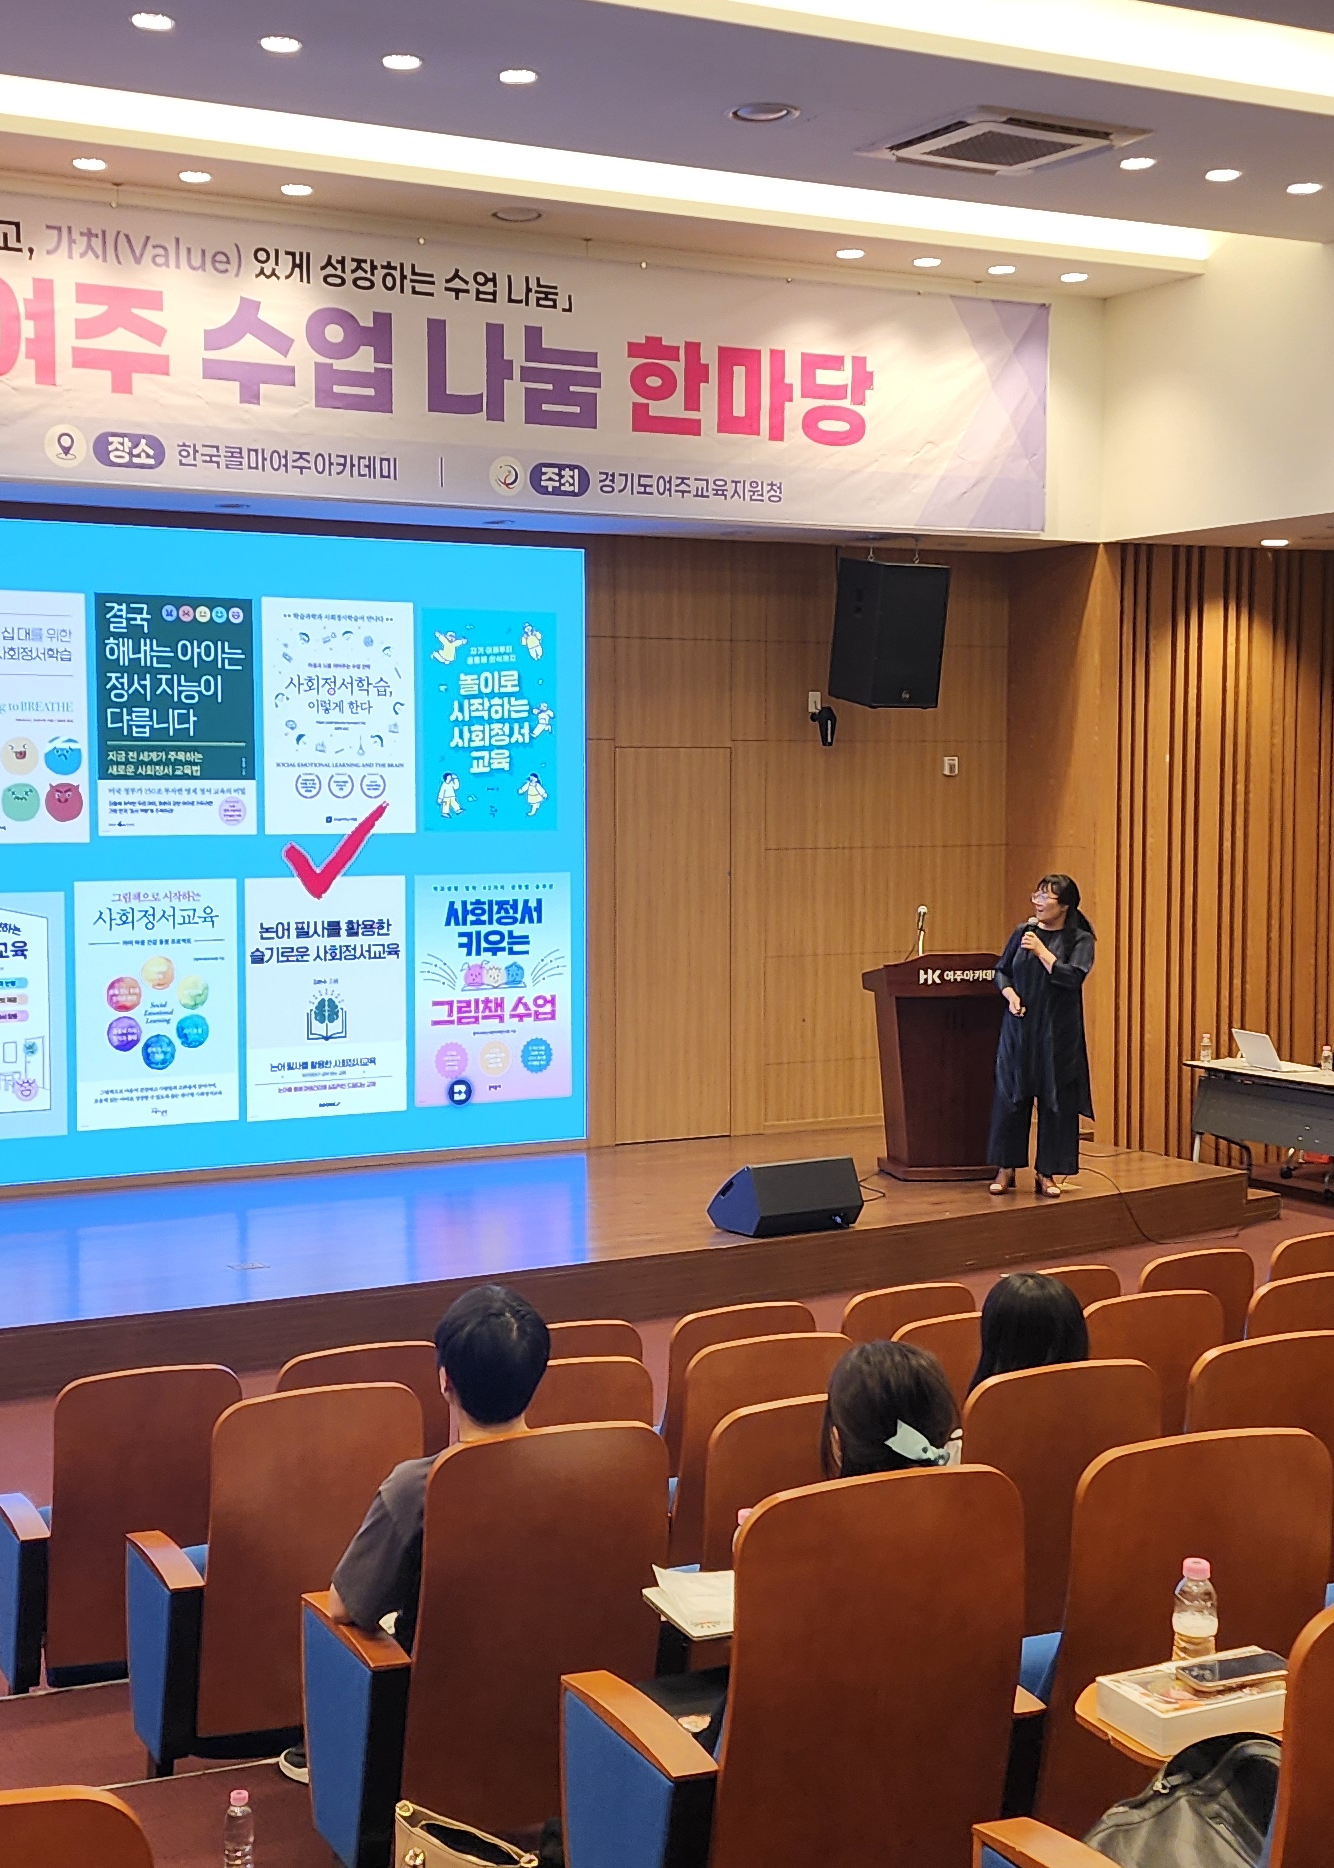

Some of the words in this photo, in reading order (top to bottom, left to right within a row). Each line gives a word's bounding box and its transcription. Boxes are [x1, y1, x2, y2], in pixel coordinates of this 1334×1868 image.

[45, 223, 242, 277] 가치(Value)
[253, 247, 311, 284] 있게
[320, 254, 436, 297] 성장하는
[444, 268, 498, 303] 수업
[506, 274, 573, 313] 나눔」
[201, 295, 395, 415] 수업
[425, 317, 603, 430] 나눔
[626, 334, 874, 447] 한마당
[108, 436, 155, 464] 장소
[177, 442, 399, 481] 한국콜마여주아카데미
[540, 467, 579, 493] 주최
[599, 471, 784, 503] 경기도여주교육지원청
[104, 602, 151, 633] 결국
[1, 626, 15, 641] 십
[46, 628, 72, 643] 위한
[104, 636, 174, 668] 해내는
[177, 639, 245, 670] 아이는
[105, 672, 151, 702] 정서
[156, 673, 222, 704] 지능이
[285, 674, 393, 698] 사회정서학습,
[459, 670, 519, 695] 놀이로
[20, 701, 74, 713] BREATHE
[308, 699, 344, 714] 이렇게
[348, 700, 373, 714] 한다
[450, 697, 529, 722] 시작하는
[106, 707, 198, 737] 다릅니다
[450, 722, 530, 748] 사회정서
[107, 751, 126, 762] 지금
[127, 751, 138, 762] 전
[139, 751, 166, 762] 세계가
[168, 752, 203, 762] 주목하는
[469, 748, 510, 774] 교육
[107, 765, 135, 776] 새로운
[137, 765, 172, 776] 사회정서
[174, 765, 201, 776] 교육법
[111, 892, 161, 903] 그림책으로
[162, 890, 201, 902] 시작하는
[93, 905, 219, 931] 사회정서교육
[444, 898, 543, 927] 사회정서
[259, 921, 291, 940] 논어
[294, 920, 342, 939] 필사를
[345, 918, 392, 938] 활용한
[250, 946, 310, 964] 슬기로운
[313, 943, 401, 962] 사회정서교육
[458, 930, 531, 957] 키우는
[919, 969, 942, 985] HK
[943, 969, 996, 982] 여주아카데
[431, 996, 505, 1026] 그림책
[509, 993, 557, 1022] 수업
